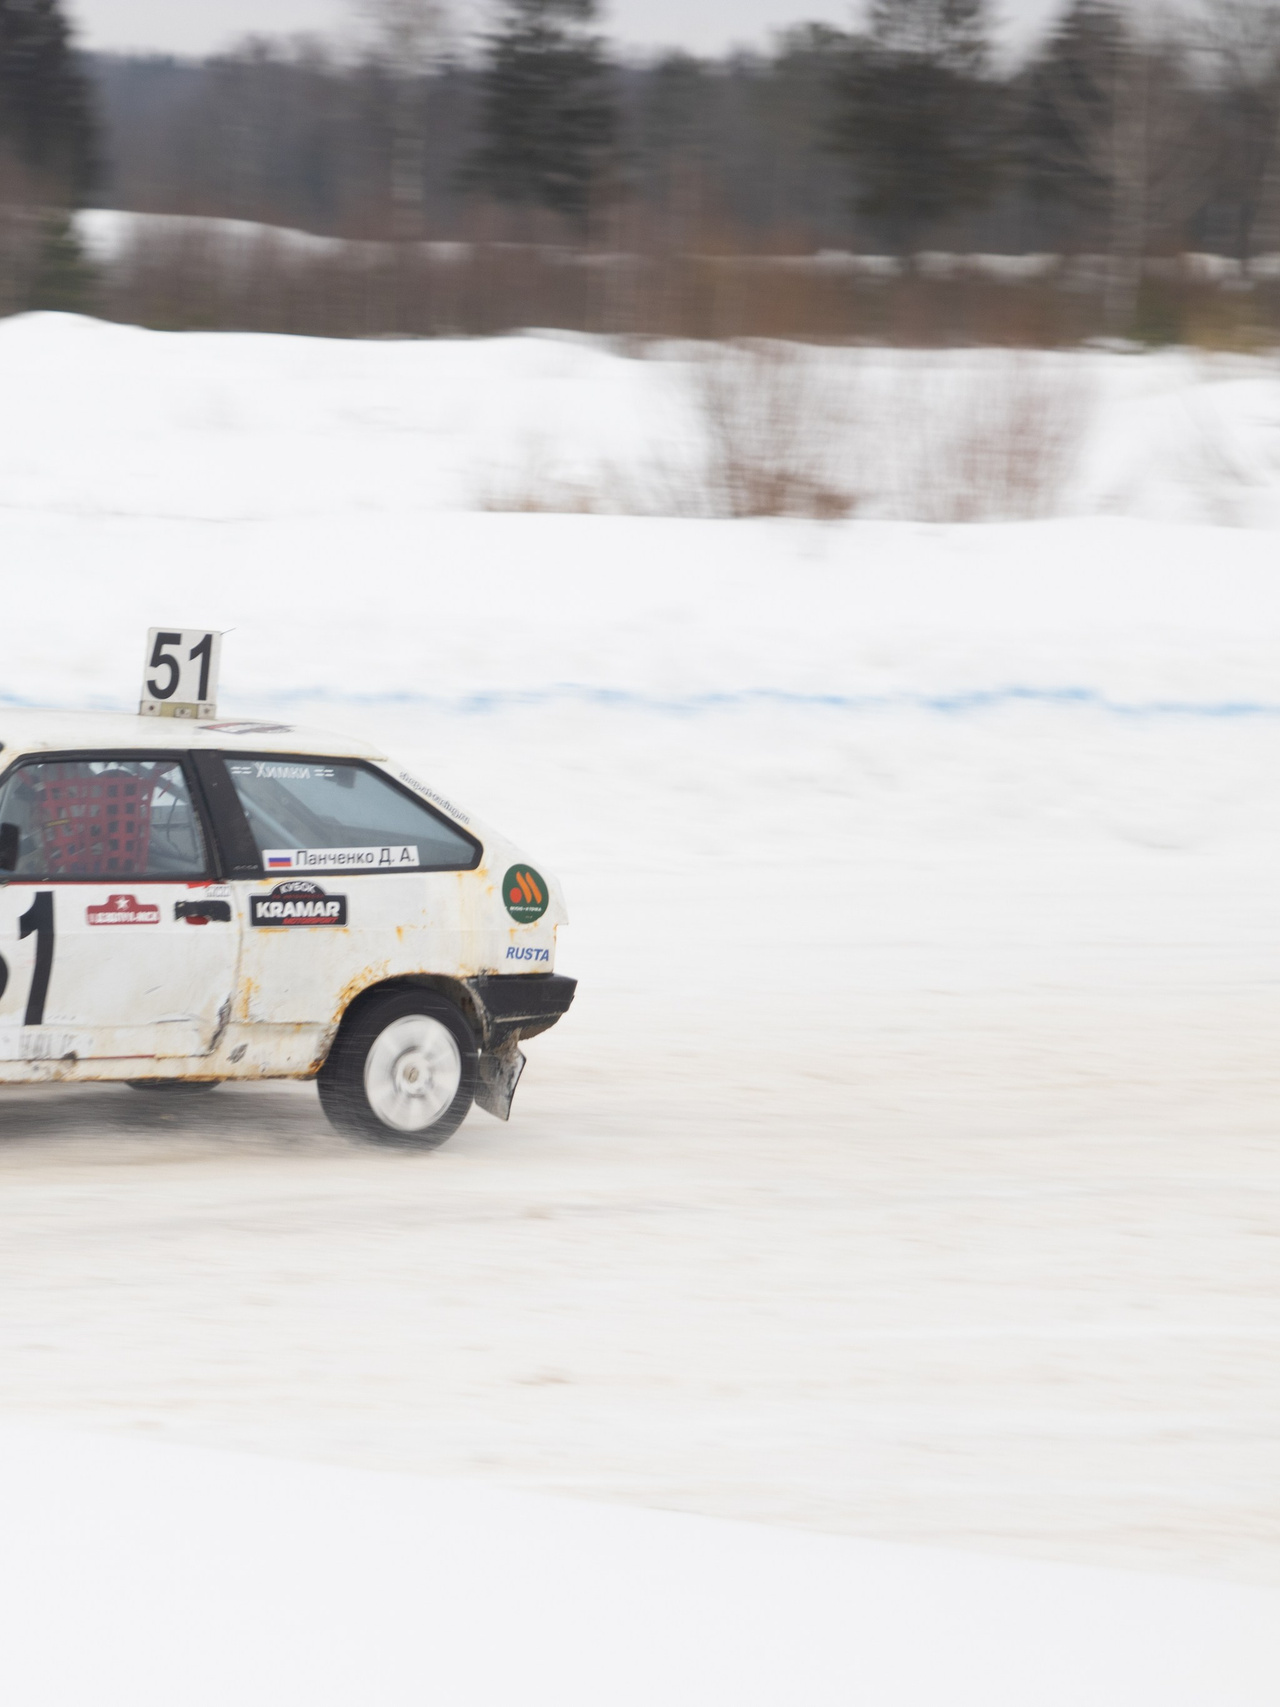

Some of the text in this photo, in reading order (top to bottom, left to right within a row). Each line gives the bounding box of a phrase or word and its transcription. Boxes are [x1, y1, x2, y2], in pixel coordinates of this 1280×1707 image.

[147, 632, 213, 701] 51
[296, 847, 416, 866] Панченко Д. А.
[256, 901, 341, 919] KRAMAR
[506, 946, 550, 961] RUSTA
